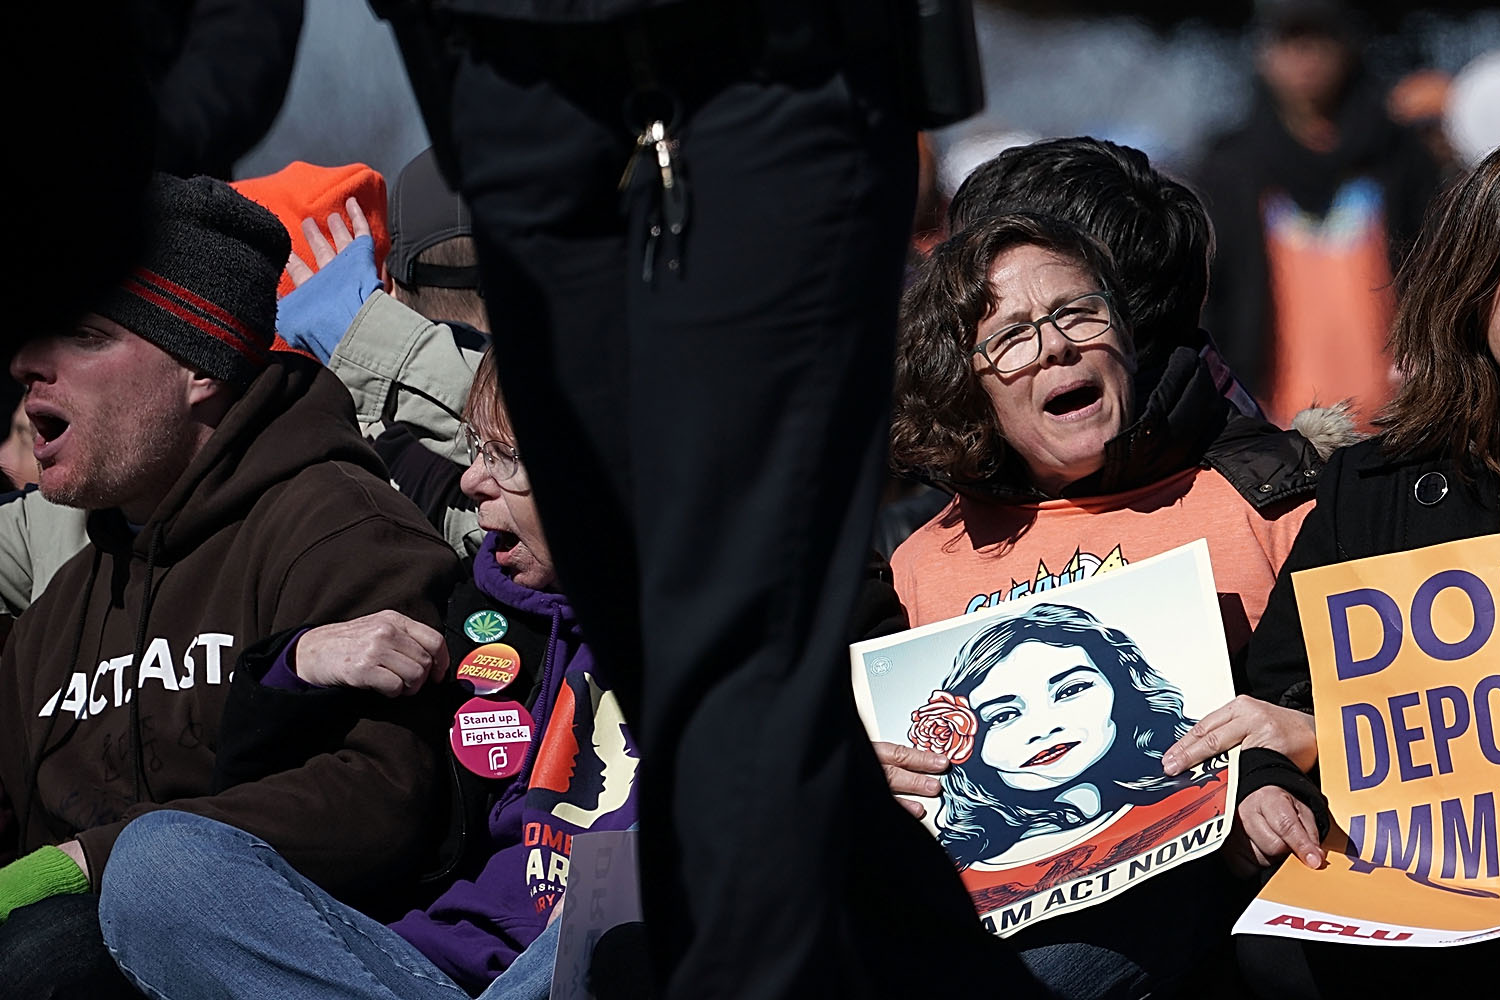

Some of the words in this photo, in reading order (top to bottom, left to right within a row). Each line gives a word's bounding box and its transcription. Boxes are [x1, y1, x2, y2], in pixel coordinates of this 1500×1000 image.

[473, 655, 512, 669] DEFEND
[458, 664, 514, 683] DREAMERS
[463, 713, 496, 725] Stand
[498, 714, 517, 724] up.
[466, 731, 495, 743] Fight
[497, 728, 528, 739] back.
[1044, 868, 1118, 912] ACT
[1128, 817, 1225, 880] NOW!
[1264, 914, 1413, 941] ACLU
